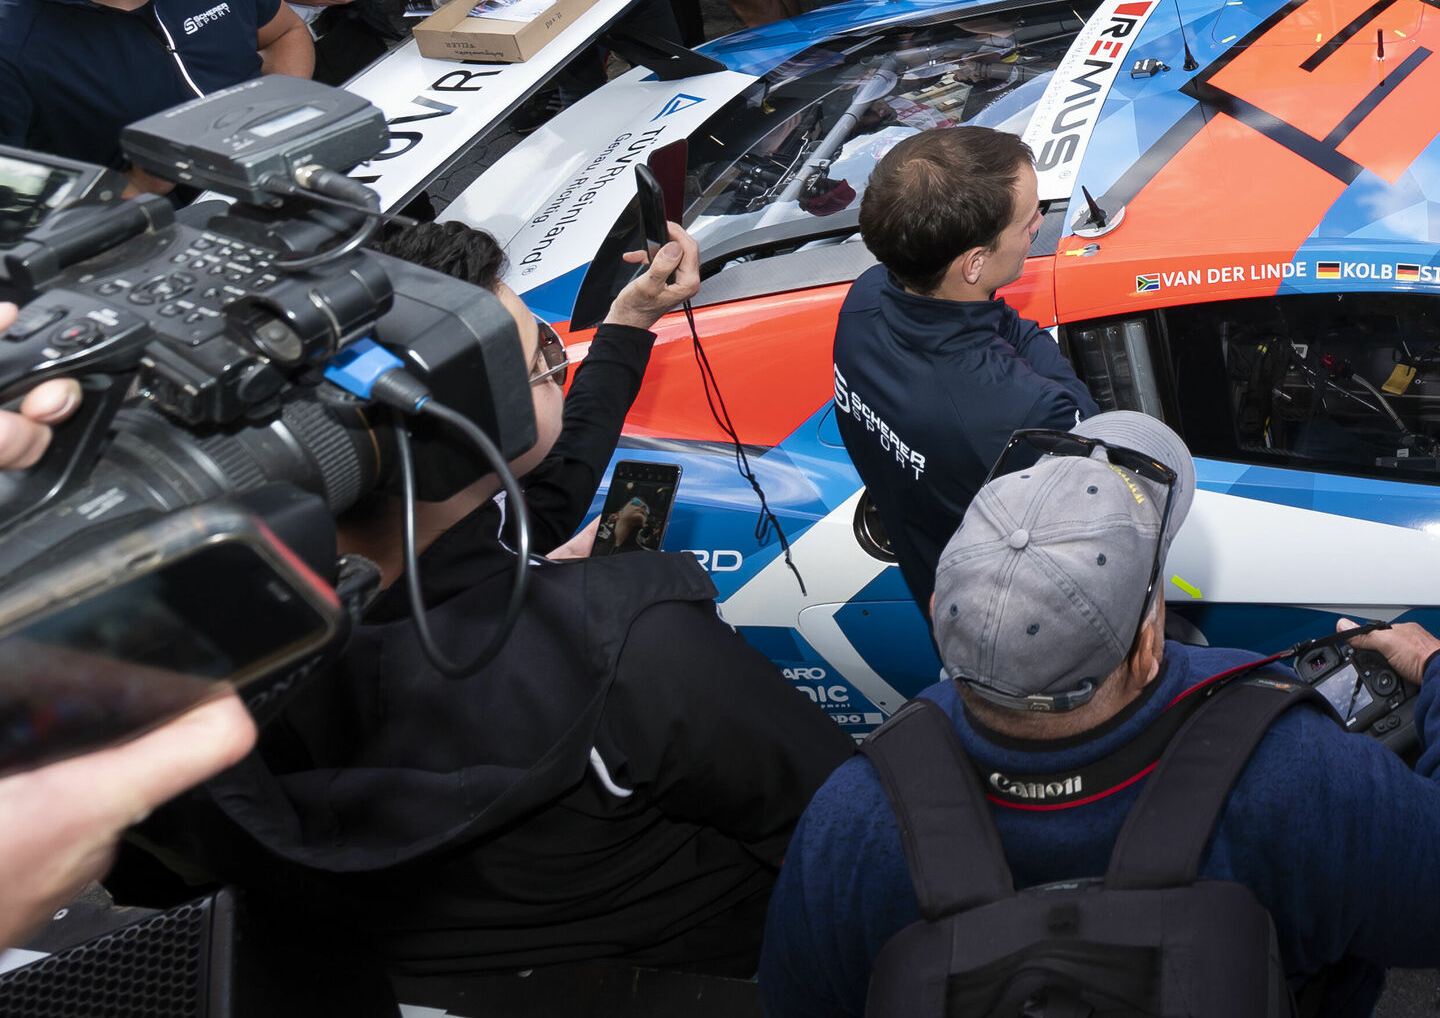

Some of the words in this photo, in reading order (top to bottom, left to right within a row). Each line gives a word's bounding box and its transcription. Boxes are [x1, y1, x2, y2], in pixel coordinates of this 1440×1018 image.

[1034, 17, 1139, 172] REMUS
[585, 132, 632, 179] Genau.
[518, 125, 667, 268] TÜVRheinland
[530, 175, 590, 229] Richtig.
[1161, 269, 1204, 287] VAN
[1206, 266, 1246, 284] DER
[1248, 261, 1307, 282] LINDE
[1343, 262, 1393, 280] KOLB
[850, 391, 926, 470] SCHERER
[850, 407, 926, 481] SPORT
[989, 771, 1082, 799] Canon
